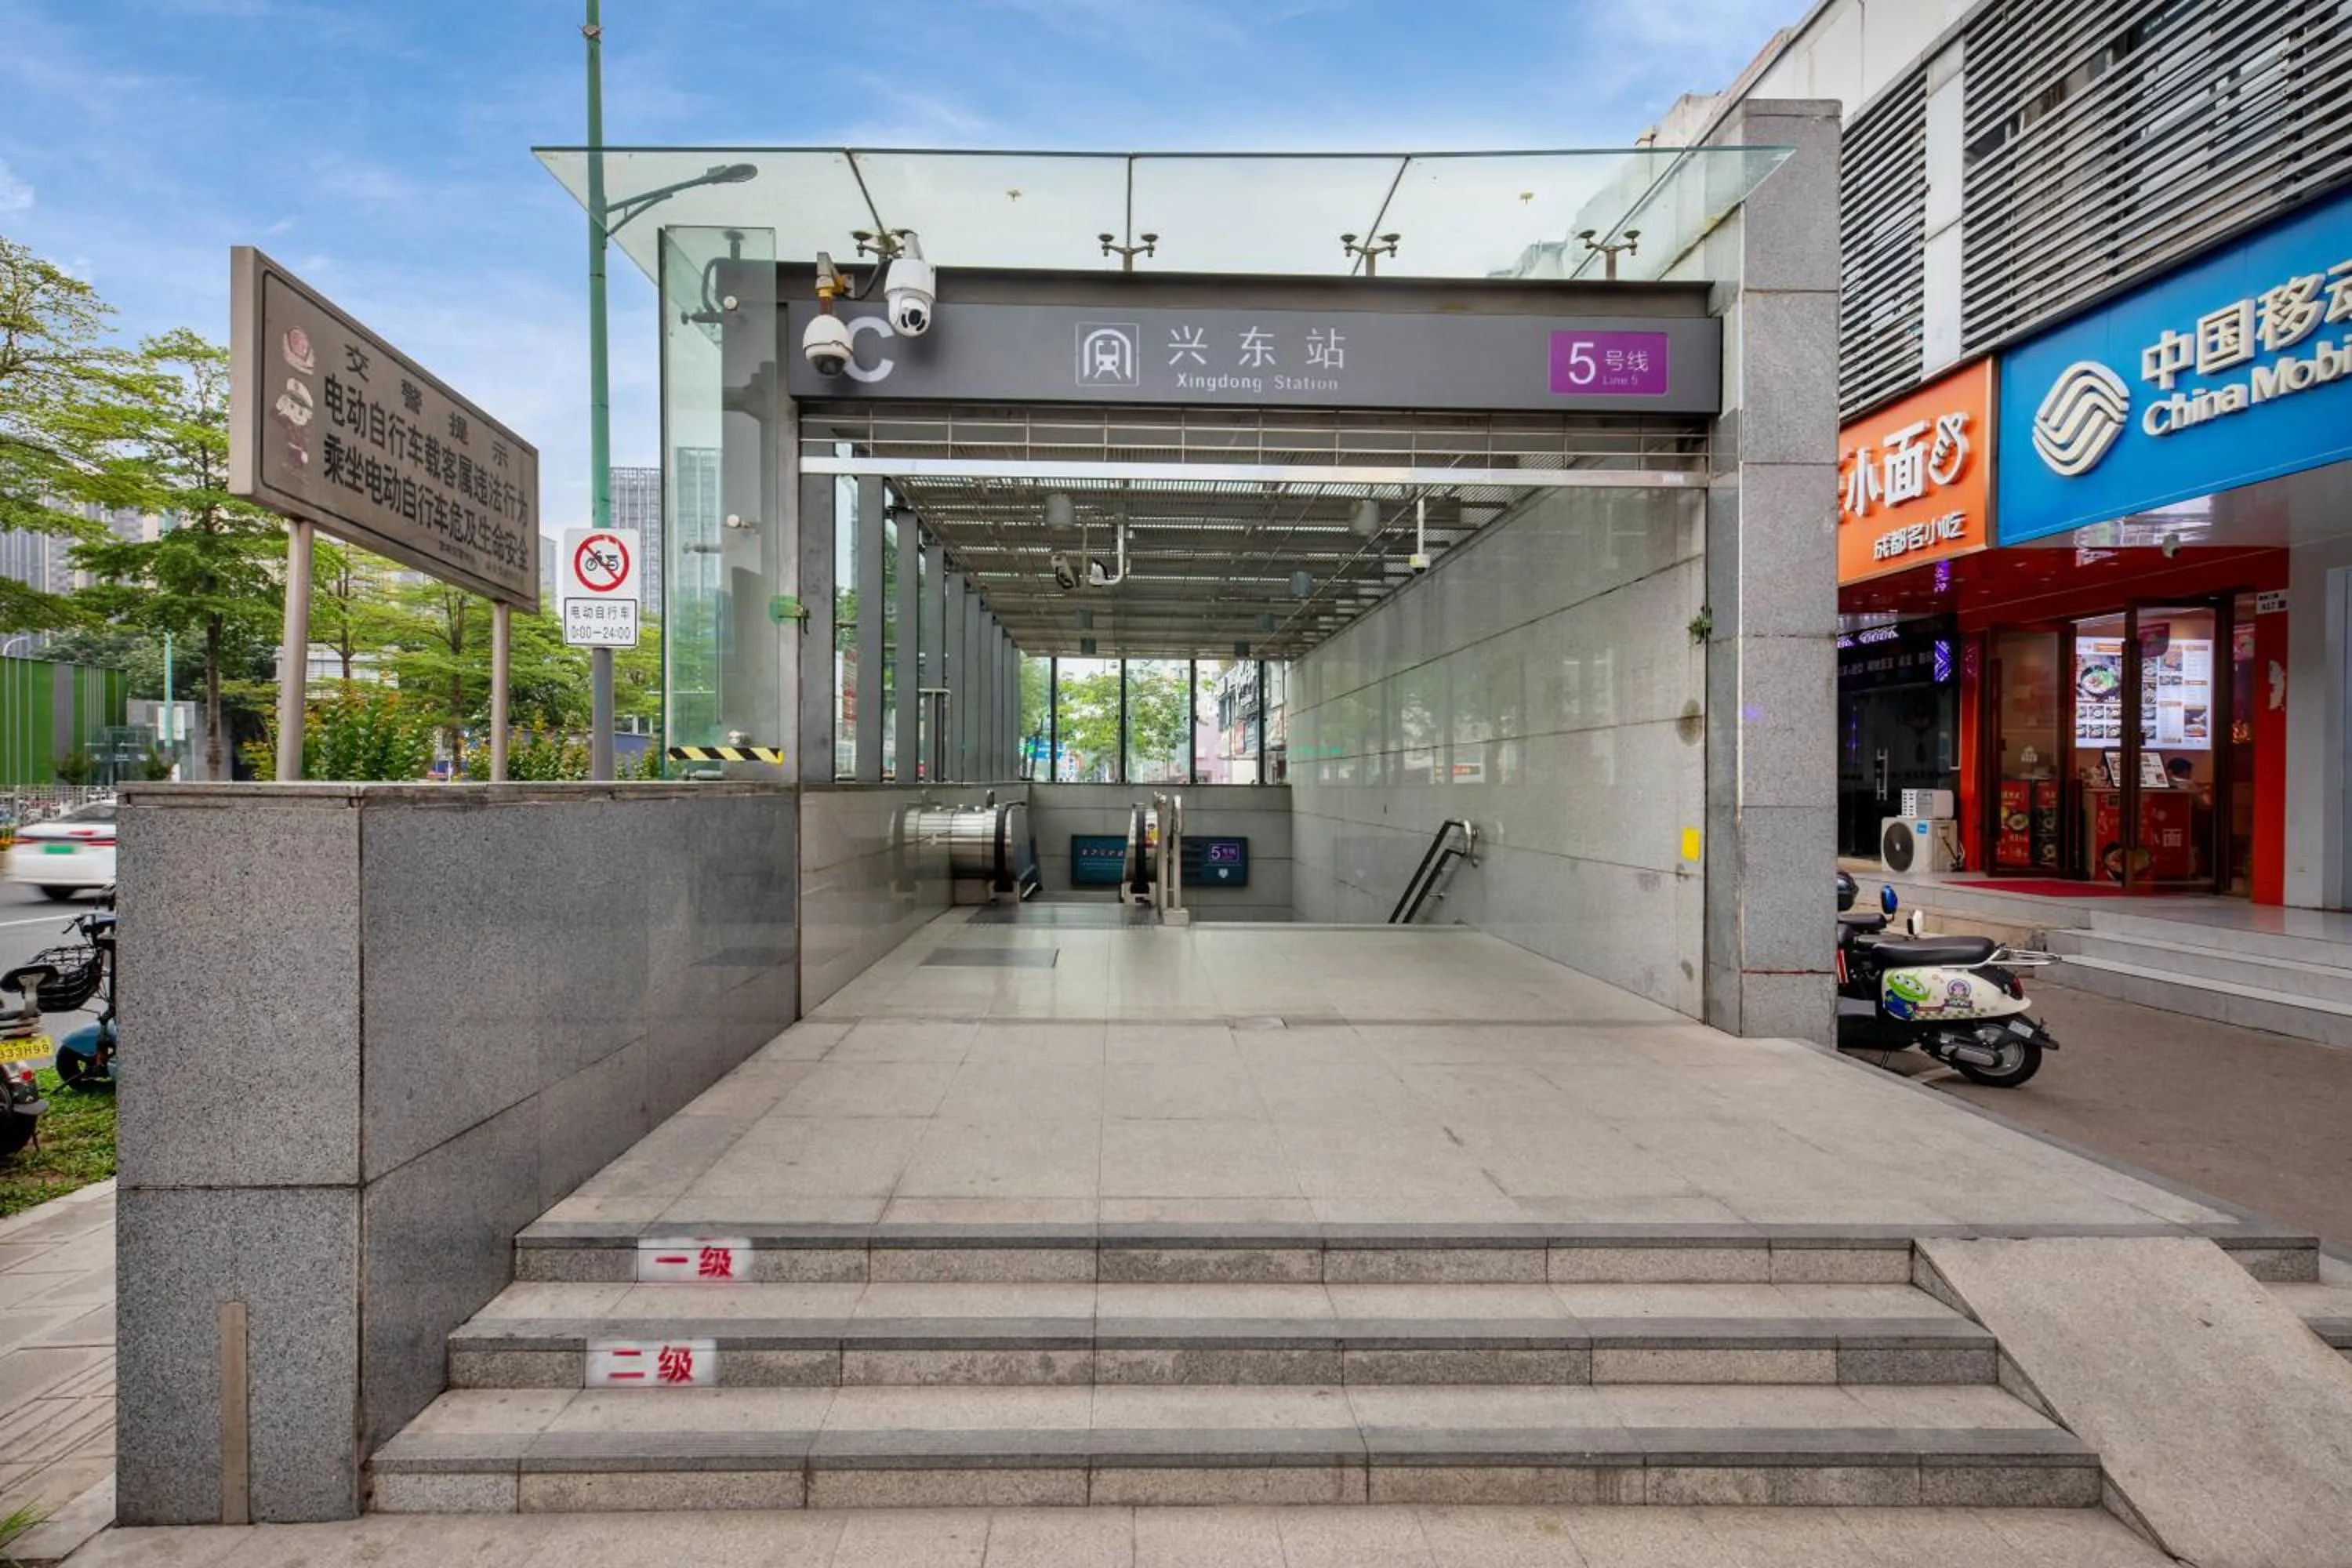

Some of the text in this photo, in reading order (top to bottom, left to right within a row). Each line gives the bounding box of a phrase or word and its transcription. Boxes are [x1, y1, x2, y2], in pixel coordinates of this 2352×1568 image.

[843, 316, 895, 383] C
[1167, 325, 1347, 369] 兴东站
[345, 343, 509, 468] 交警提示
[1176, 372, 1338, 392] Xingdong Station
[1602, 376, 1628, 386] Line
[2142, 383, 2249, 436] China
[324, 372, 528, 528] 电动自行车载客属违法行为
[1838, 419, 1932, 518] 小面
[324, 432, 528, 572] 乘坐电动自行车危及生命安全
[1873, 511, 1967, 561] 成都名小吃
[571, 605, 630, 621] 电动自行车
[655, 1245, 732, 1279] 一级
[608, 1345, 694, 1384] 二级
